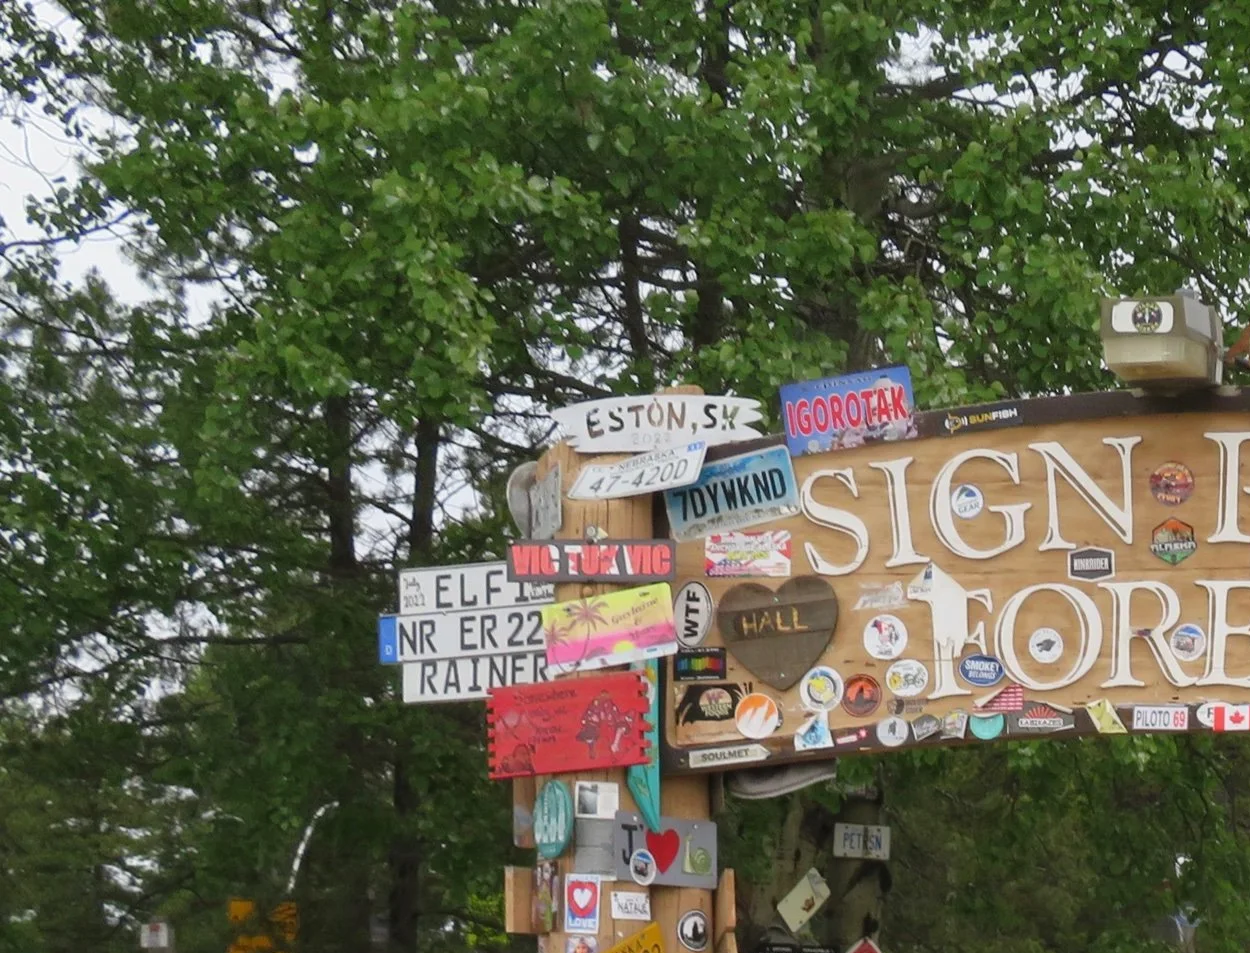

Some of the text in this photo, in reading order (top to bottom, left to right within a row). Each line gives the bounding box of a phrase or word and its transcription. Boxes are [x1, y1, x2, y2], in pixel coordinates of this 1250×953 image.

[703, 402, 740, 431] SK
[786, 383, 910, 437] IGOROTAK
[968, 407, 1018, 426] SUNFISH
[618, 449, 676, 472] NEBRASKA
[673, 468, 788, 521] 7DYWKND
[800, 435, 1143, 575] SIGN
[512, 545, 560, 576] VIC
[624, 544, 671, 576] VIC
[682, 589, 700, 638] WTF
[742, 608, 809, 635] HALL
[399, 610, 544, 656] NR ER 22
[420, 653, 550, 695] RAINER
[964, 658, 1000, 671] SMOKEY
[1135, 709, 1186, 729] PILOTO 69
